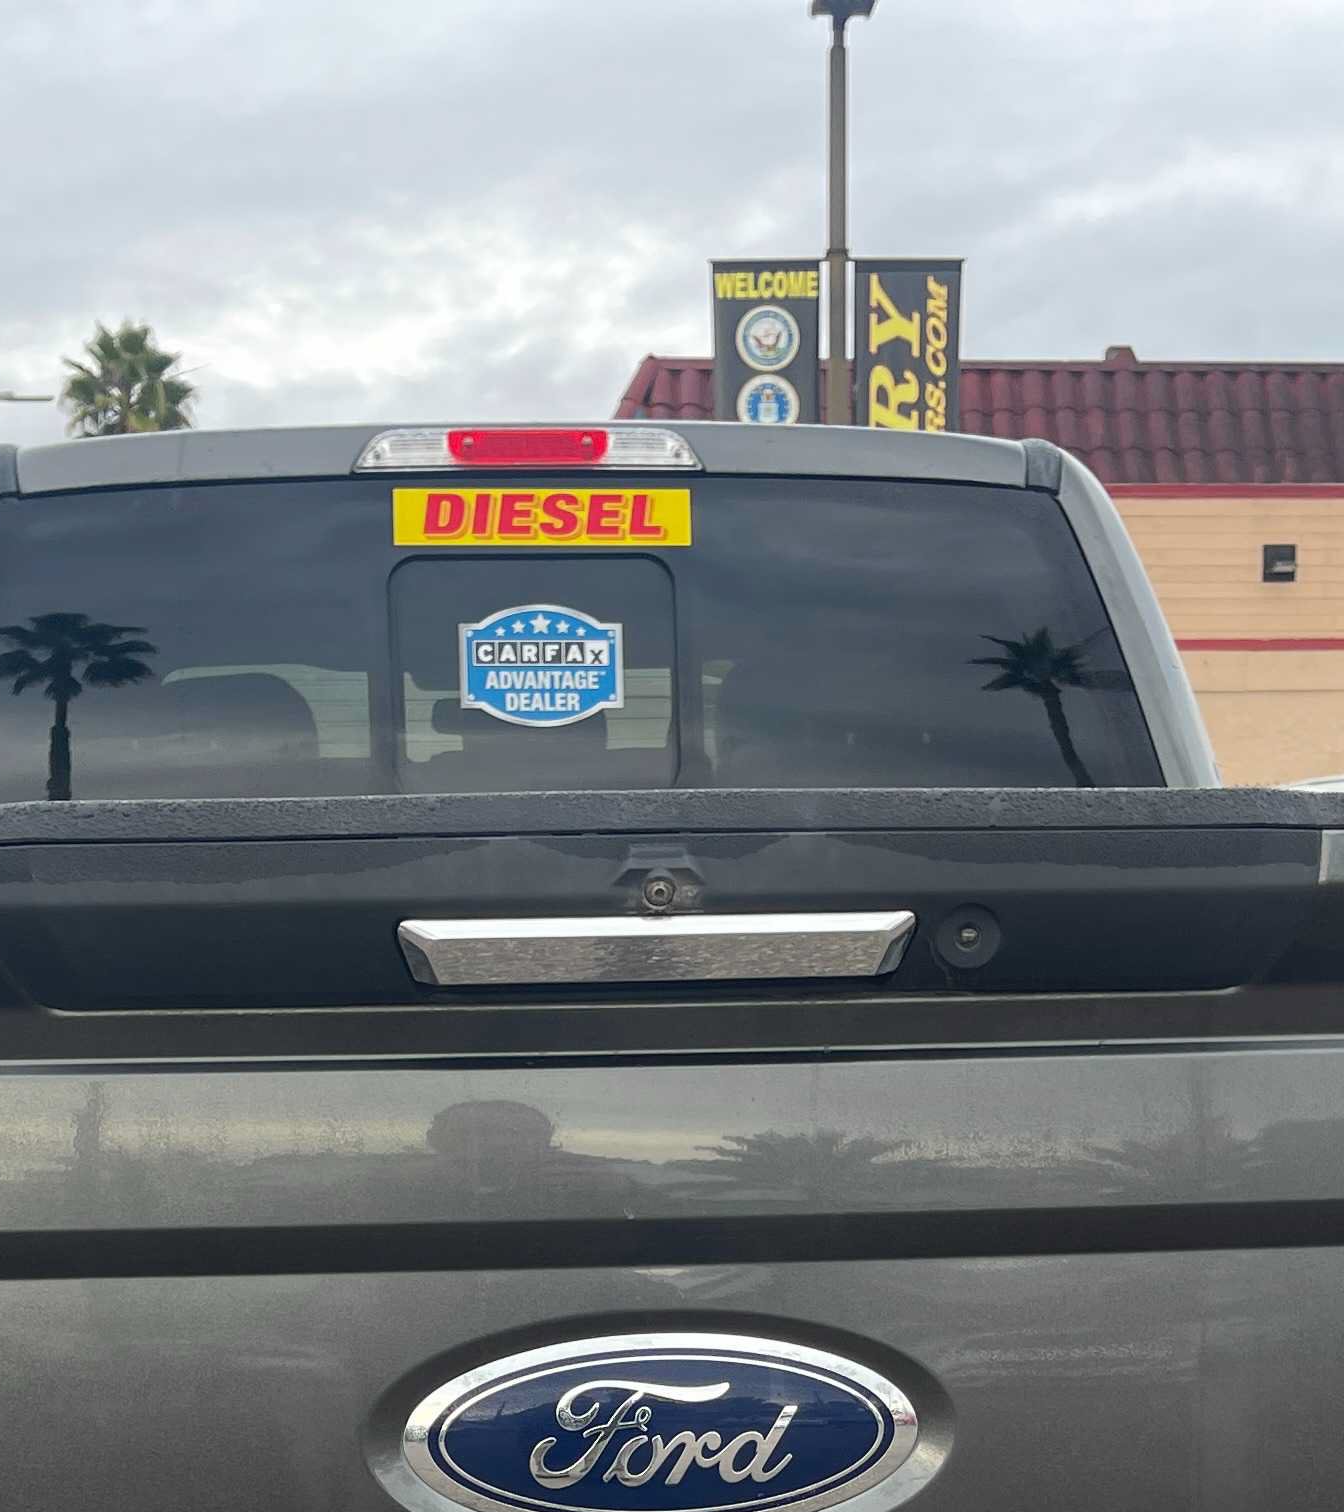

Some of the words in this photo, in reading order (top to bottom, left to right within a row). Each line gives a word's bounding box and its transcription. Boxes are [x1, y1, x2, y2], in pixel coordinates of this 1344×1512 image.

[714, 271, 819, 299] WELCOME
[422, 493, 667, 540] DIESEL
[475, 641, 608, 665] CARFAX
[485, 670, 600, 690] ADVANTAGE
[506, 692, 580, 712] DEALER
[529, 1380, 798, 1488] Ford
